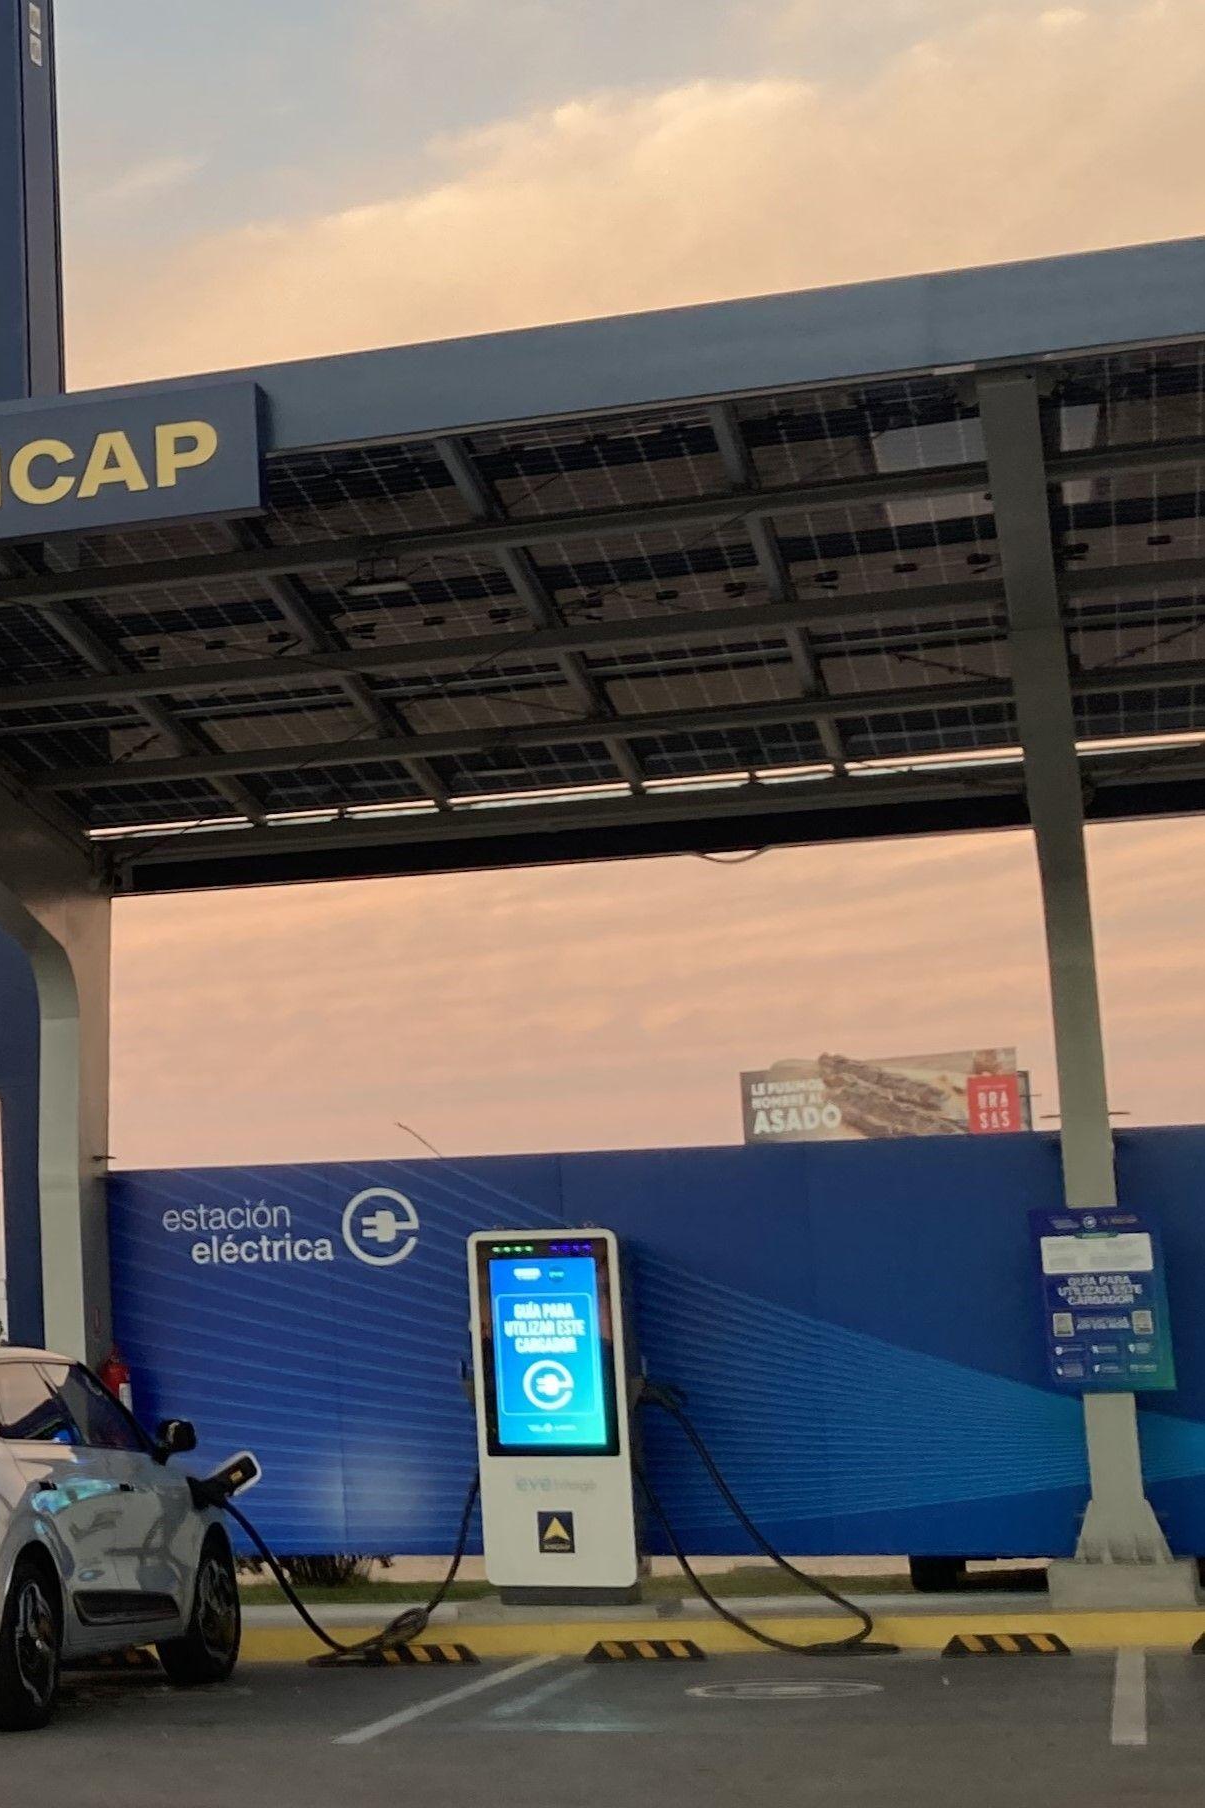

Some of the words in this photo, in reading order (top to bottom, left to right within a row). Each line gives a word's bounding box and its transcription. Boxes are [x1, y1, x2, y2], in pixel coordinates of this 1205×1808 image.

[754, 1102, 842, 1135] ASADO
[162, 1199, 291, 1232] estación
[191, 1233, 335, 1265] eléctrica
